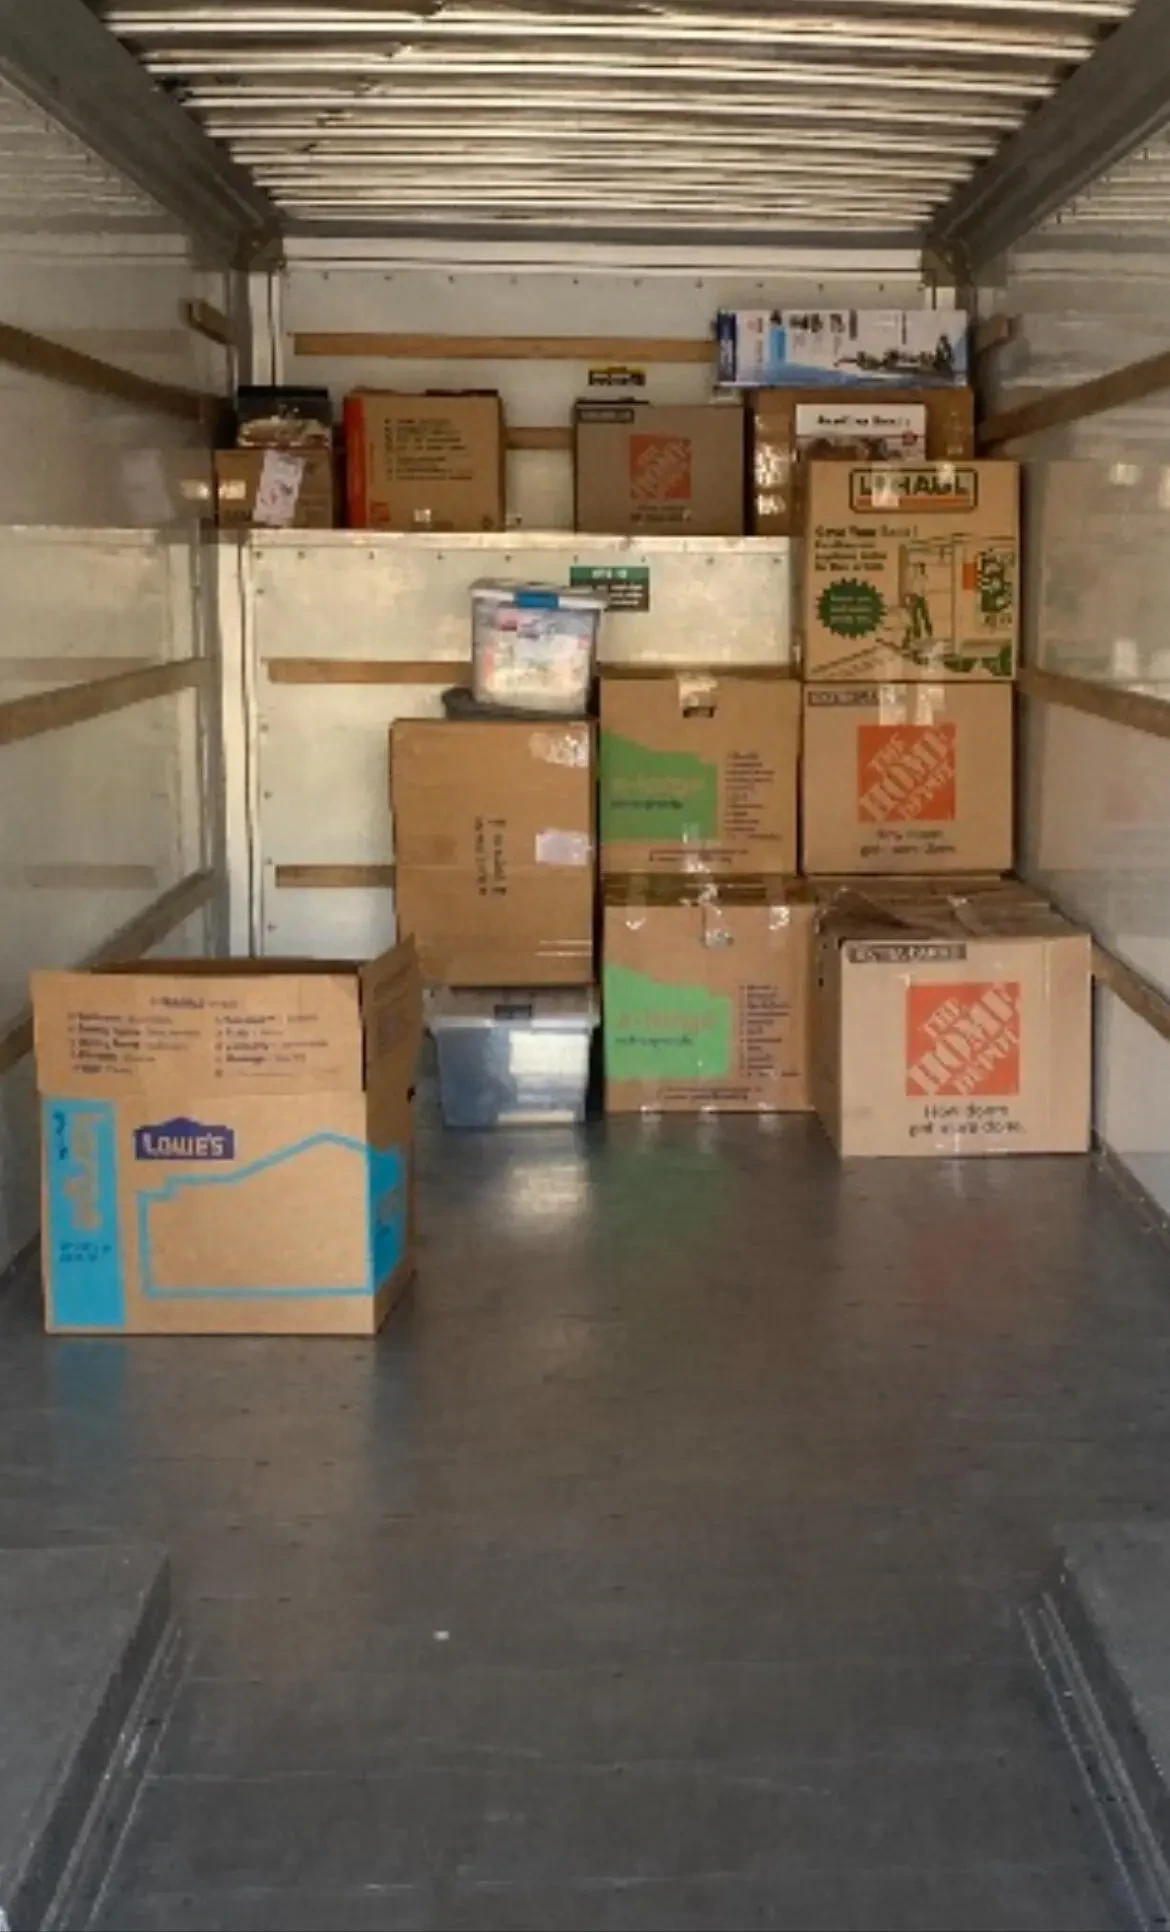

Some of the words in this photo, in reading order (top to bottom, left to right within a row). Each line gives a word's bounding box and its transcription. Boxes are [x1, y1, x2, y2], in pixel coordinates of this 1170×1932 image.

[860, 475, 970, 496] UHAUL
[860, 729, 956, 820] HOME
[908, 981, 1019, 1095] HOME
[922, 997, 961, 1038] THE
[143, 1132, 225, 1157] LOWE'S
